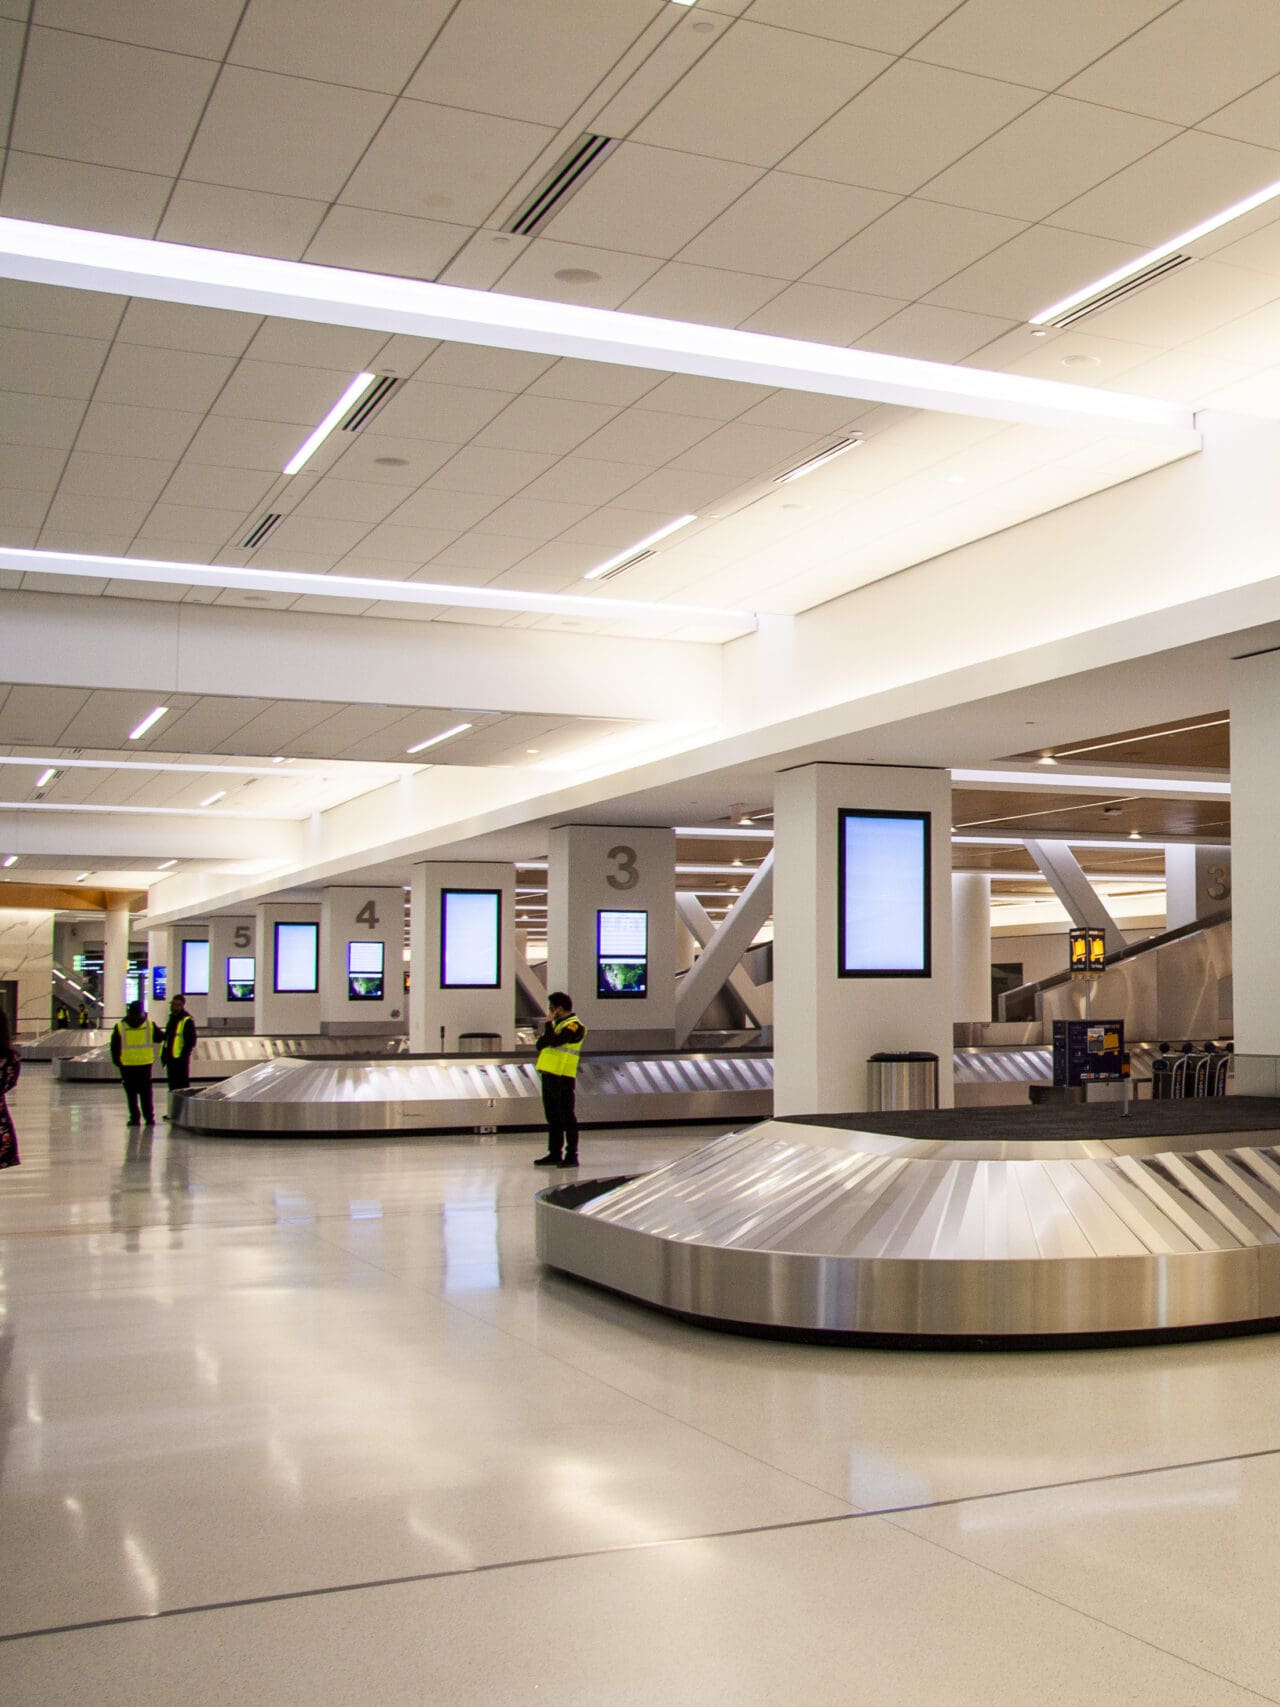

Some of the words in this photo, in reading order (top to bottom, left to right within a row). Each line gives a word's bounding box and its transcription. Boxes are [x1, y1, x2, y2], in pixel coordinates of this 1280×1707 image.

[606, 845, 639, 890] 3
[1207, 864, 1231, 900] 3
[356, 900, 380, 929] 4
[234, 926, 251, 948] 5
